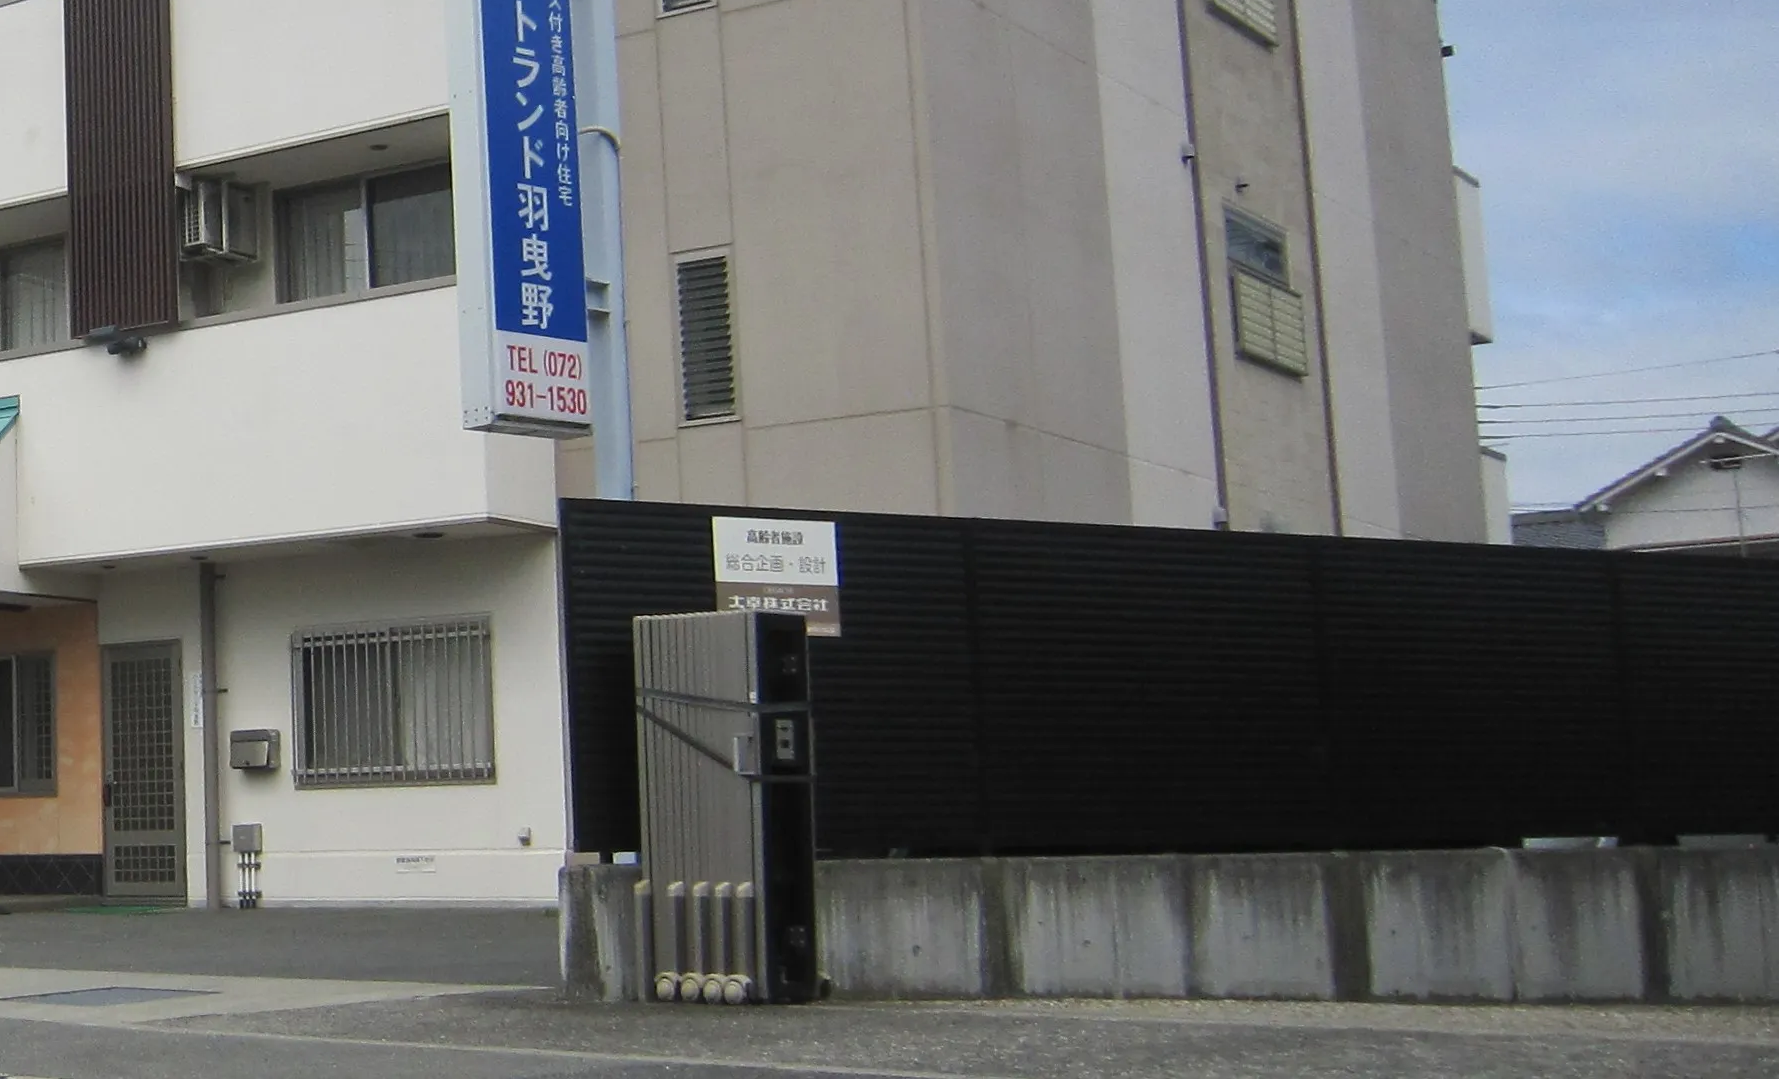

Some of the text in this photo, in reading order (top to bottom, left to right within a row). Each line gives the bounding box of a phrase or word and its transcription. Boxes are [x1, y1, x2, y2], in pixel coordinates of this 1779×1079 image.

[506, 344, 583, 380] TEL (072)
[504, 379, 588, 415] 931-1530
[746, 528, 804, 545] 高齢者施設
